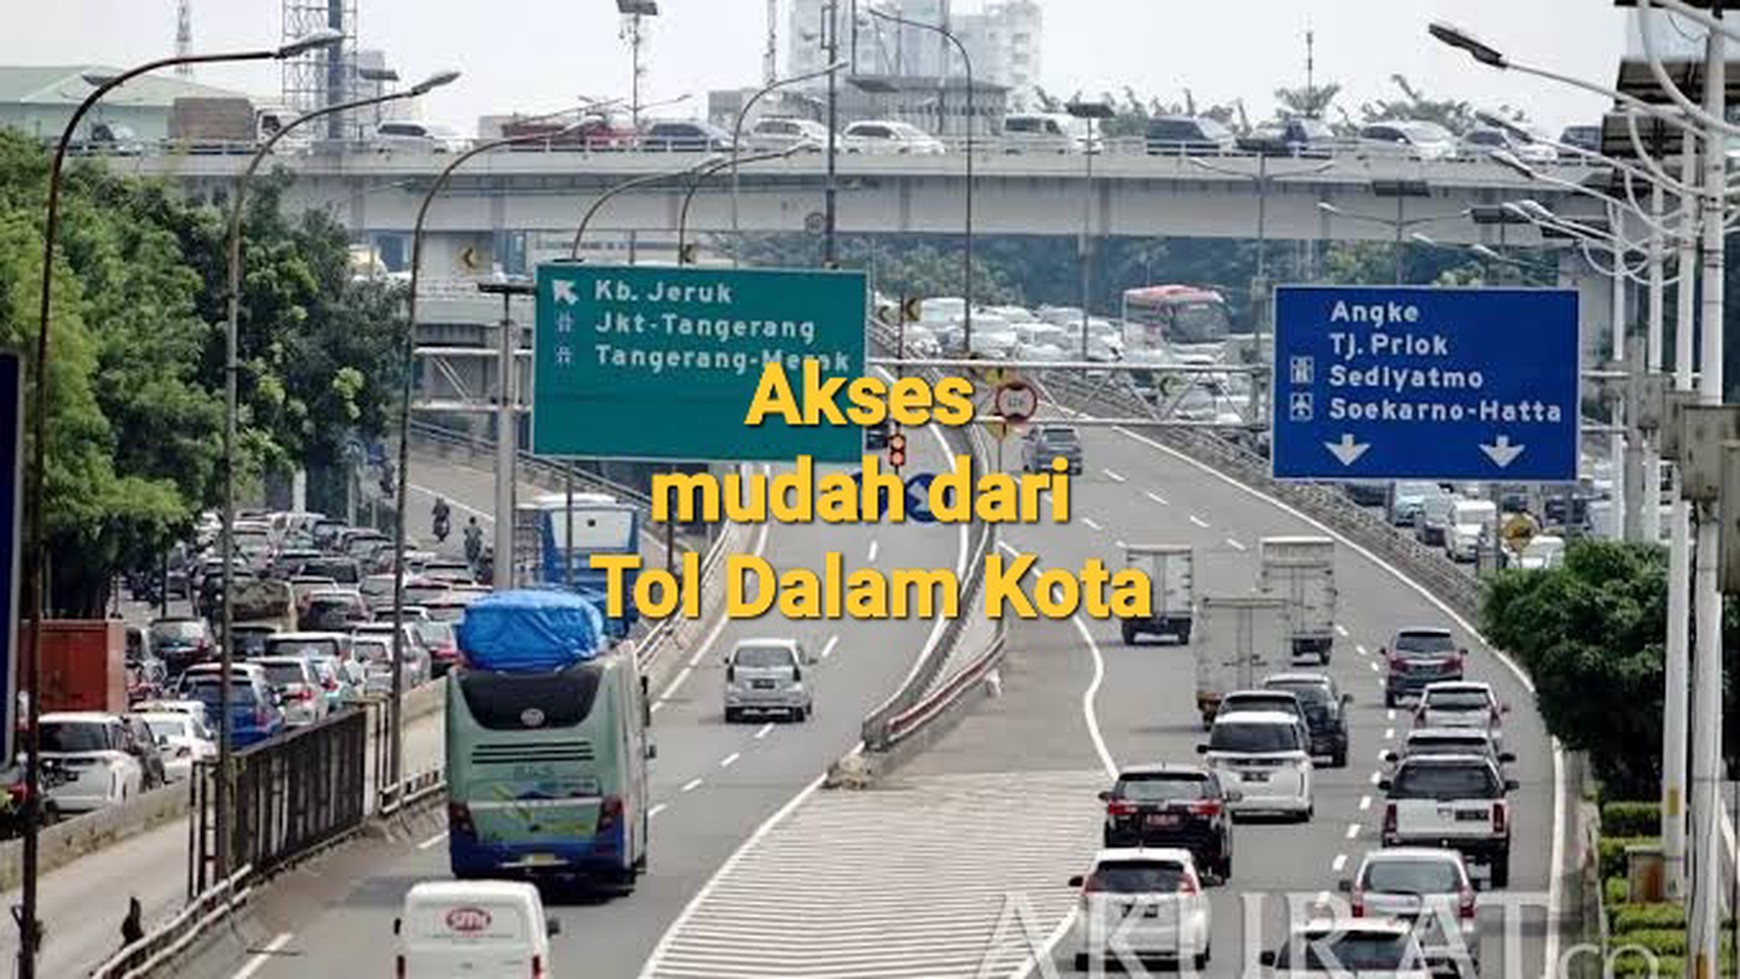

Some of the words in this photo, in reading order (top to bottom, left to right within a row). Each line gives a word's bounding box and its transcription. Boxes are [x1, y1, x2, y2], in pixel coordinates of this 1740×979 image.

[595, 279, 638, 301] Kb.
[647, 282, 732, 303] Jeruk
[596, 312, 815, 343] Jkt-Tangerang
[1330, 301, 1420, 328] Angke
[1329, 333, 1364, 360] Tj.
[1371, 333, 1449, 356] Priok
[1329, 364, 1484, 392] Sediyatmo
[1329, 398, 1562, 423] Soekarno-Hatta
